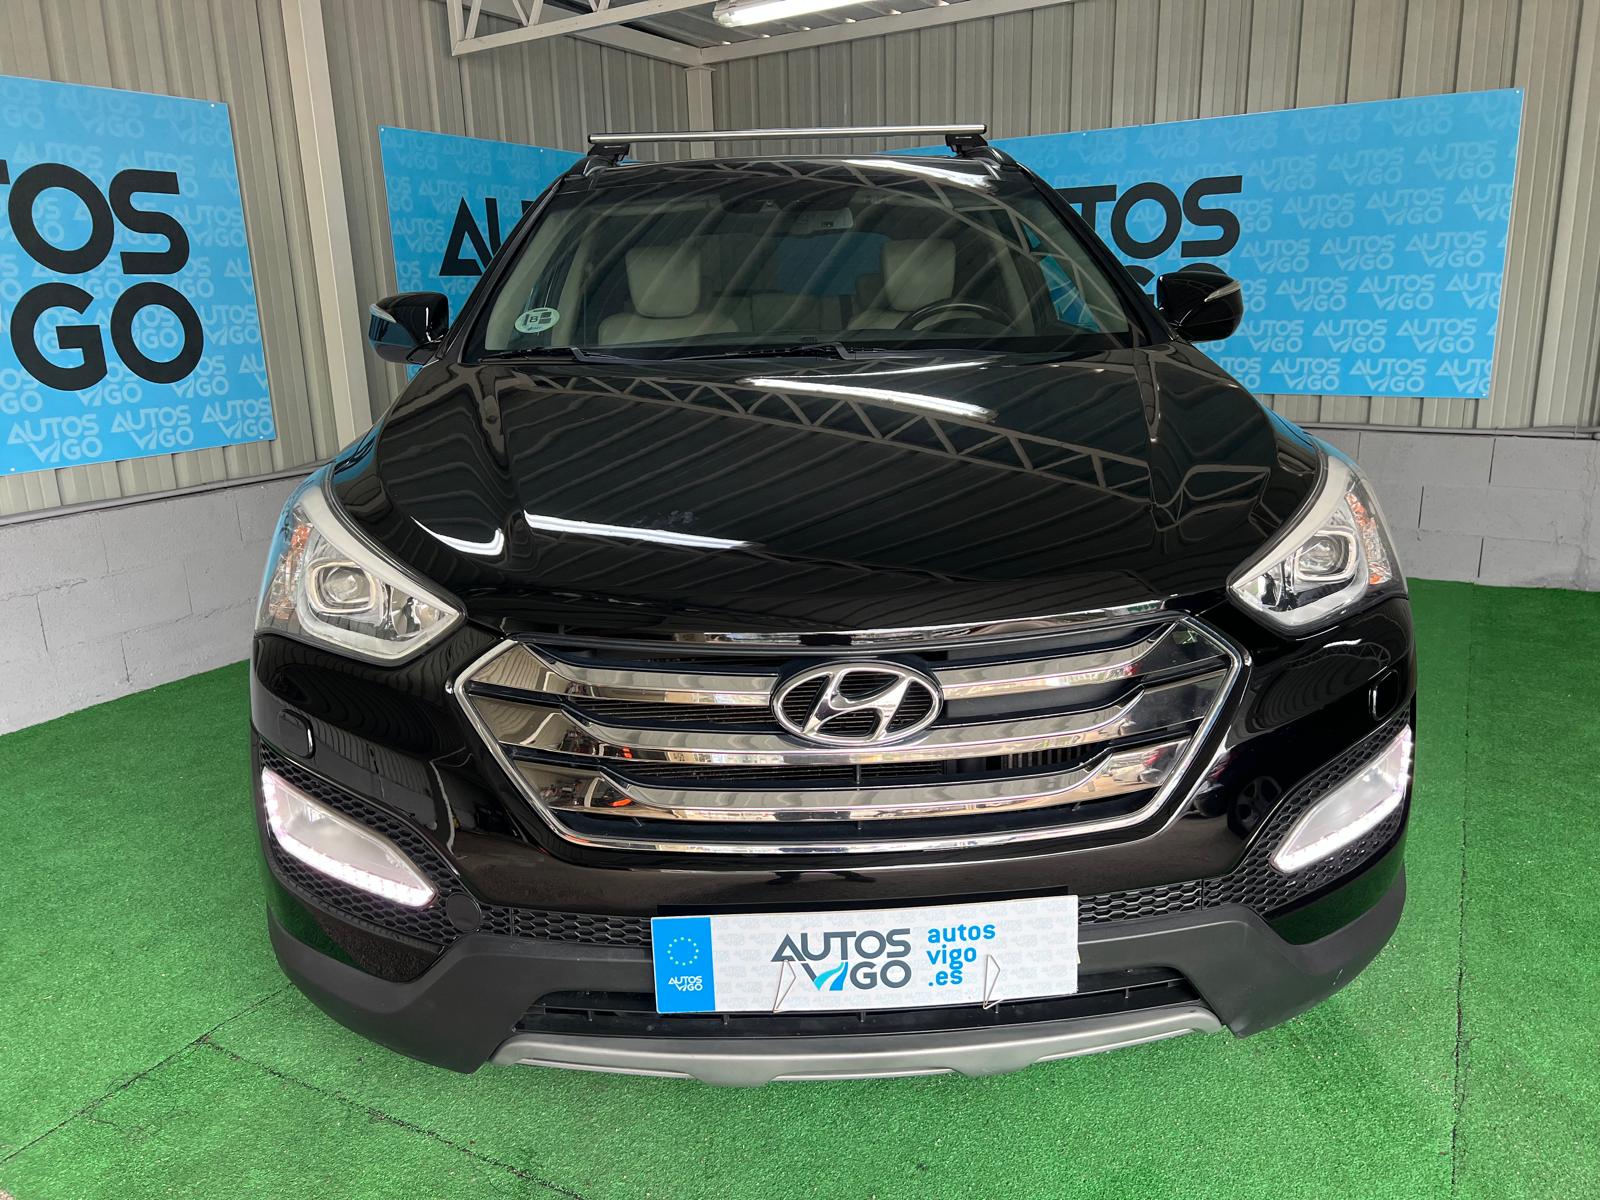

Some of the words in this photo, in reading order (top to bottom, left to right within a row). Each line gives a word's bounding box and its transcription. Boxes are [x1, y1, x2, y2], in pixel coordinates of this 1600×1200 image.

[1414, 140, 1498, 165] AUTOS
[1429, 160, 1496, 181] VIGO
[1281, 193, 1355, 214] AUTOS
[1365, 187, 1446, 209] AUTOS
[0, 160, 190, 275] OS
[1296, 210, 1355, 230] VIGO
[1381, 205, 1443, 226] VIGO
[1240, 238, 1312, 258] AUTOS
[1319, 234, 1396, 255] AUTOS
[1404, 230, 1488, 252] AUTOS
[1254, 255, 1310, 275] VIGO
[1335, 252, 1395, 272] VIGO
[1421, 249, 1486, 269] VIGO
[1274, 276, 1349, 296] AUTOS
[1356, 274, 1437, 294] AUTOS
[1289, 294, 1347, 312] VIGO
[1372, 292, 1434, 312] VIGO
[10, 281, 204, 391] GO
[1311, 318, 1388, 337] AUTOS
[1395, 317, 1479, 337] AUTOS
[1248, 336, 1303, 353] VIGO
[1327, 336, 1386, 354] VIGO
[1411, 335, 1476, 354] VIGO
[1268, 357, 1342, 375] AUTOS
[1349, 357, 1428, 376] AUTOS
[1283, 373, 1340, 391] VIGO
[1364, 375, 1425, 393] VIGO
[110, 404, 192, 434] AUTOS
[200, 398, 272, 424] AUTOS
[7, 412, 100, 445] AUTOS
[129, 426, 195, 450] VIGO
[216, 416, 275, 440] VIGO
[27, 436, 104, 464] VIGO
[927, 923, 996, 944] autos
[770, 927, 912, 963] AUTOS
[926, 944, 977, 970] vigo
[668, 975, 703, 985] AUTOS
[801, 959, 912, 991] VIGO
[928, 968, 963, 986] .es
[676, 983, 703, 991] VIGO
